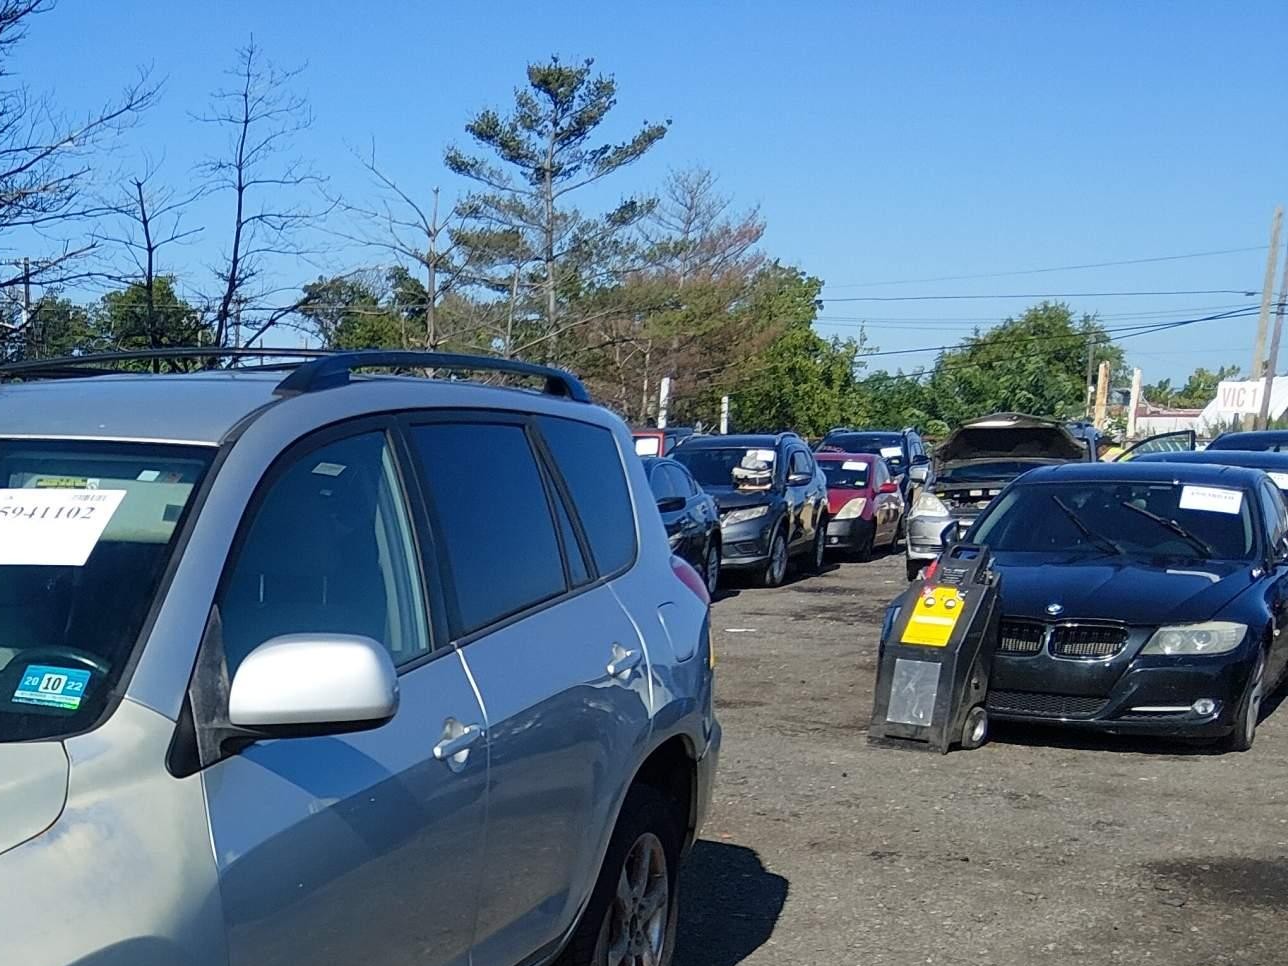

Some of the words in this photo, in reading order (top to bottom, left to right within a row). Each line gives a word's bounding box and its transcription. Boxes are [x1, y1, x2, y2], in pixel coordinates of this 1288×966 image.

[1222, 387, 1247, 408] VIC
[1251, 387, 1258, 408] 1
[24, 676, 40, 686] 20
[42, 675, 62, 691] 10
[66, 681, 83, 691] 22
